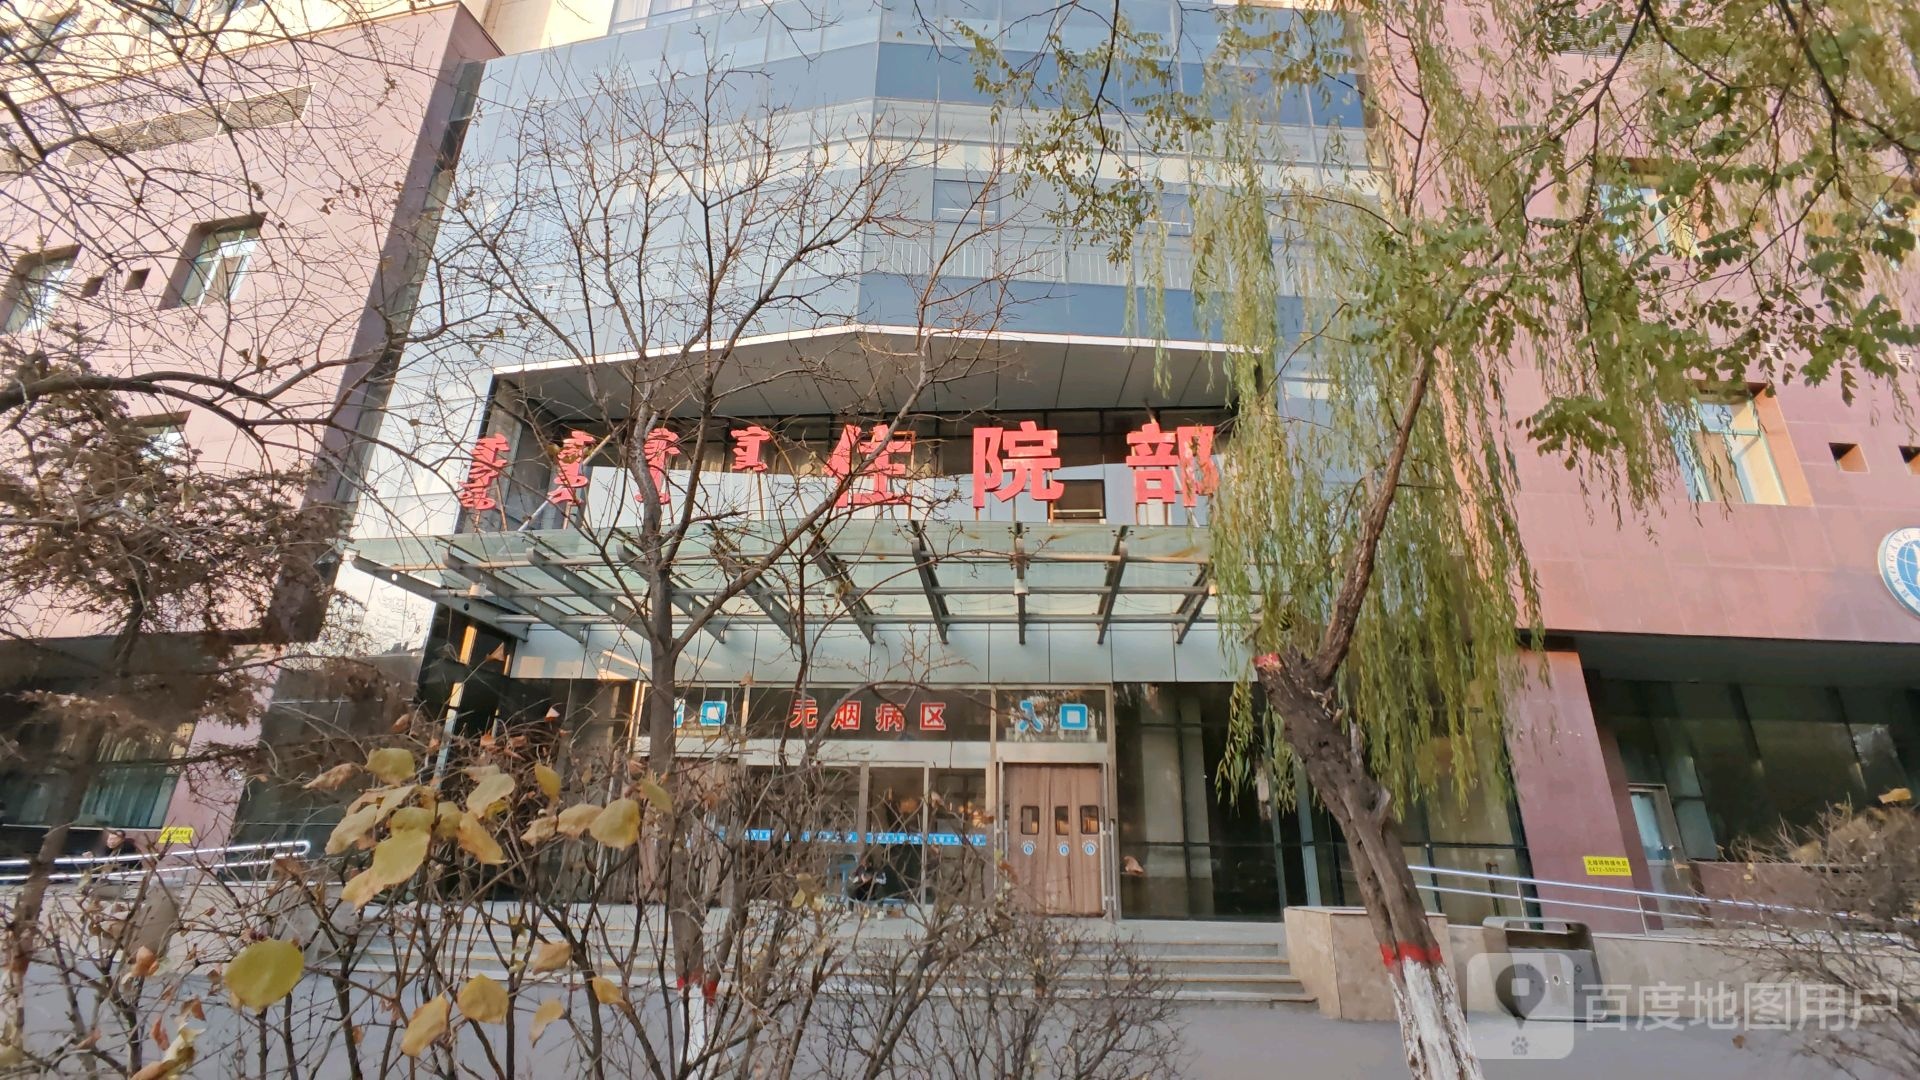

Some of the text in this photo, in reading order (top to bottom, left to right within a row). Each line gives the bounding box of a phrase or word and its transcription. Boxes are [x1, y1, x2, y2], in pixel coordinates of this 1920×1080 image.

[822, 421, 1220, 508] 住院部
[790, 699, 946, 732] 无烟病区
[1018, 699, 1089, 733] 入口
